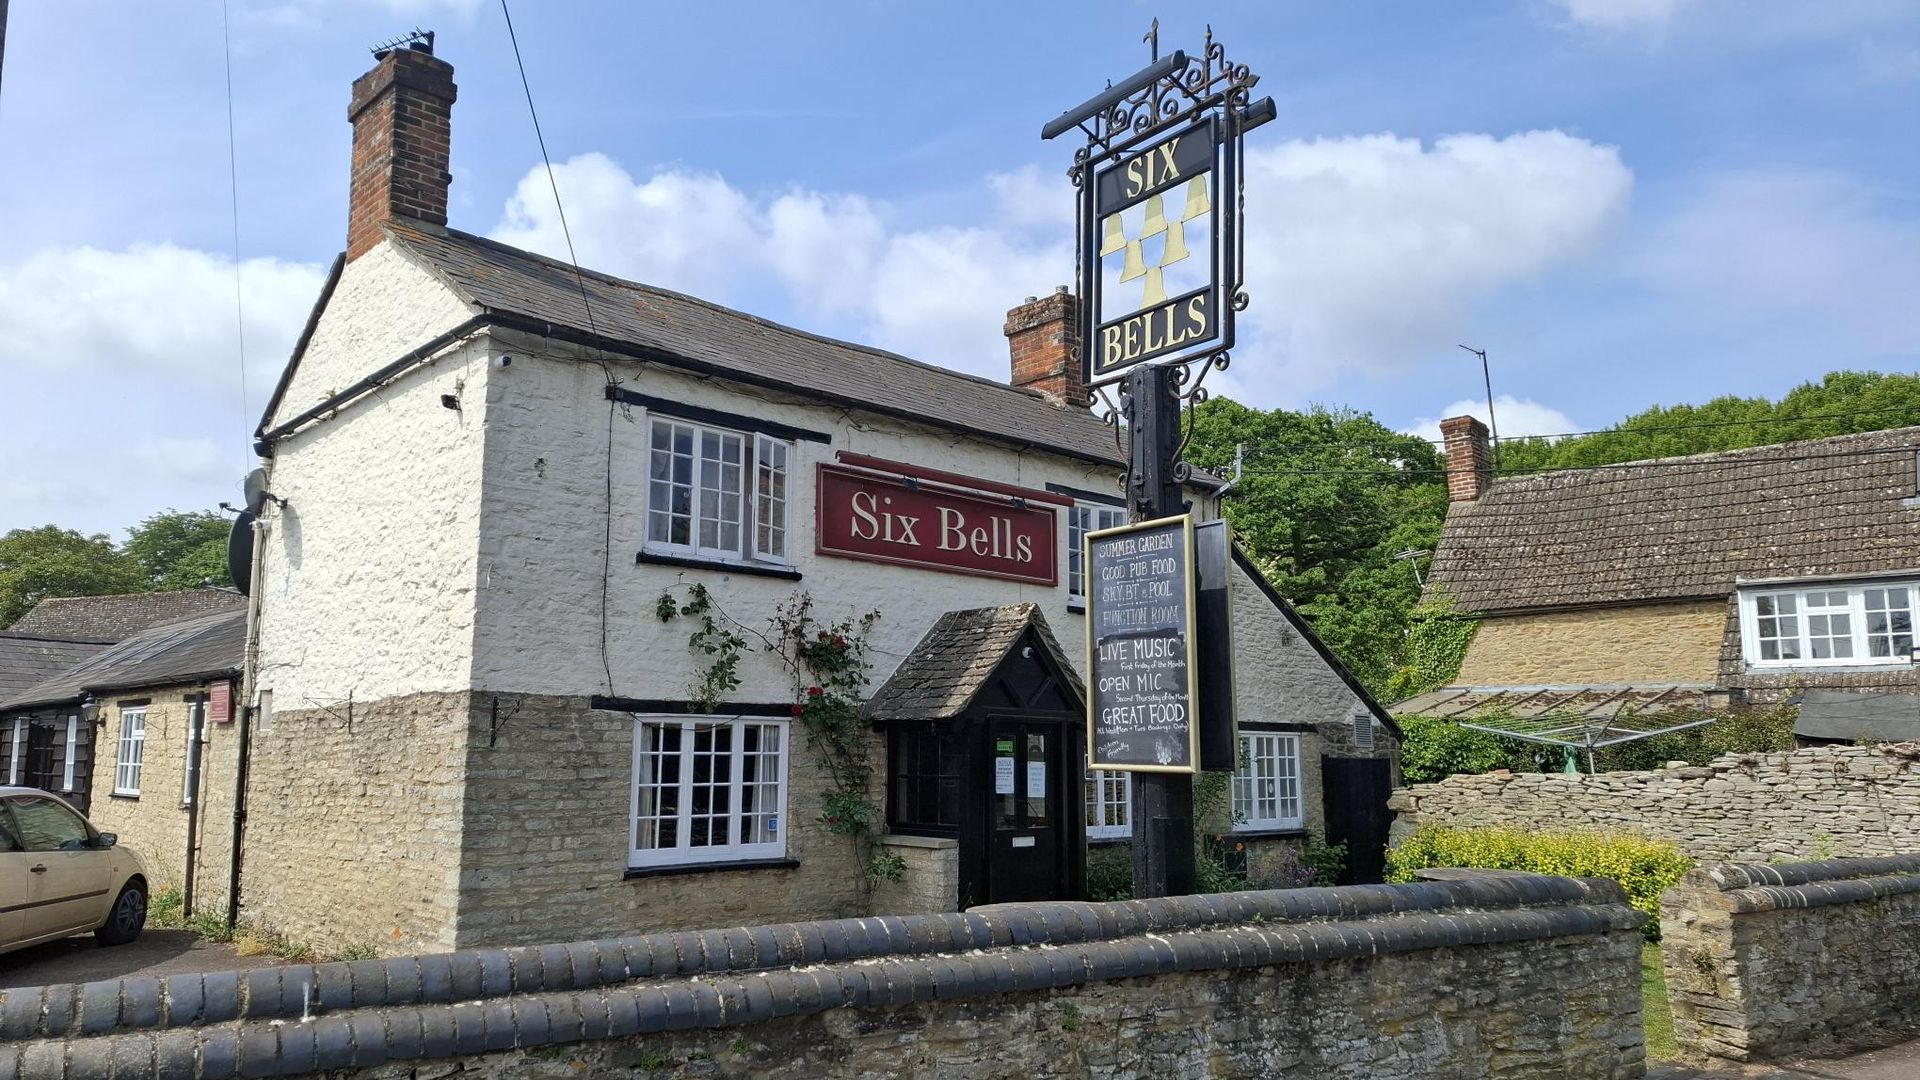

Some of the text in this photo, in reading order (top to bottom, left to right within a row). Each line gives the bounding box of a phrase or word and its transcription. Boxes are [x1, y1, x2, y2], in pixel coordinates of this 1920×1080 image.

[1126, 137, 1180, 199] SIX
[1102, 295, 1207, 368] BELLS
[851, 491, 1033, 563] Six Bells
[1099, 533, 1173, 558] SUMMER GARDEN
[1102, 557, 1176, 581] GOOD PUB FOOD
[1149, 581, 1173, 598] POOL
[1103, 604, 1180, 626] FUNCTION ROOM
[1100, 638, 1176, 662] LIVE MUSIC
[1099, 673, 1162, 692] OPEN MIC
[1102, 703, 1184, 725] GREAT FOOD
